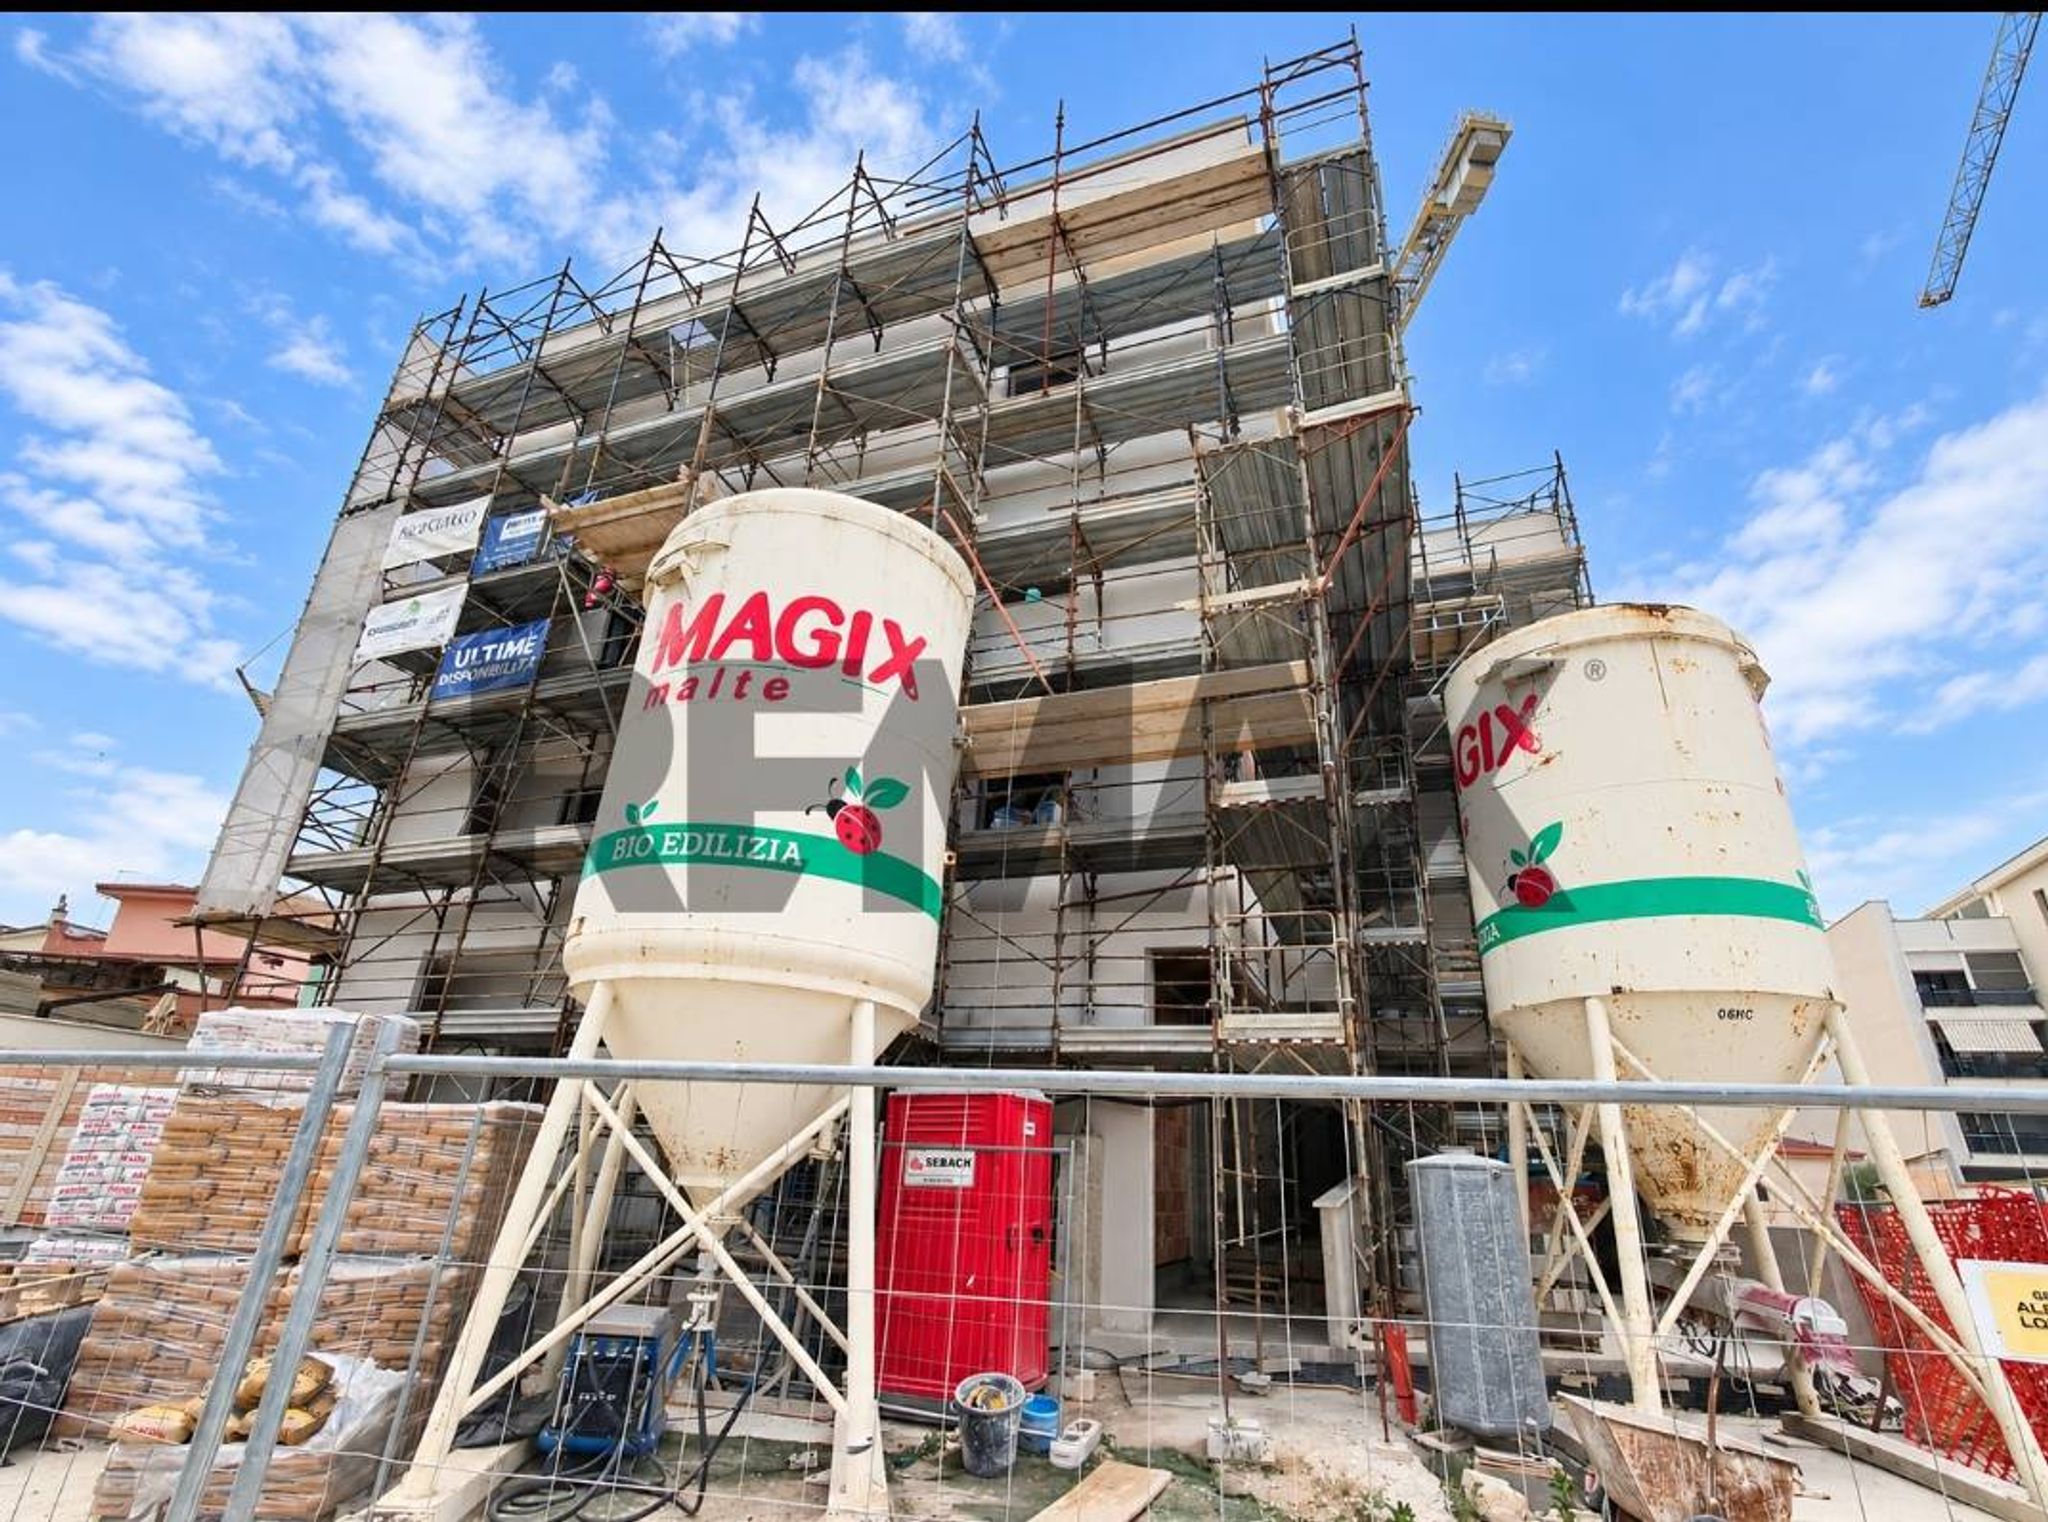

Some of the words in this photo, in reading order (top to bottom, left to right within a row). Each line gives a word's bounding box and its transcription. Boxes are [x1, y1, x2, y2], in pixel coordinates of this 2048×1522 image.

[454, 635, 539, 669] ULTIME
[652, 591, 928, 701] MAGIX
[642, 667, 791, 712] malte
[1455, 694, 1543, 790] GIX
[612, 832, 655, 860] BIO
[659, 832, 805, 866] EDILIZIA
[926, 1157, 971, 1168] SEBACH
